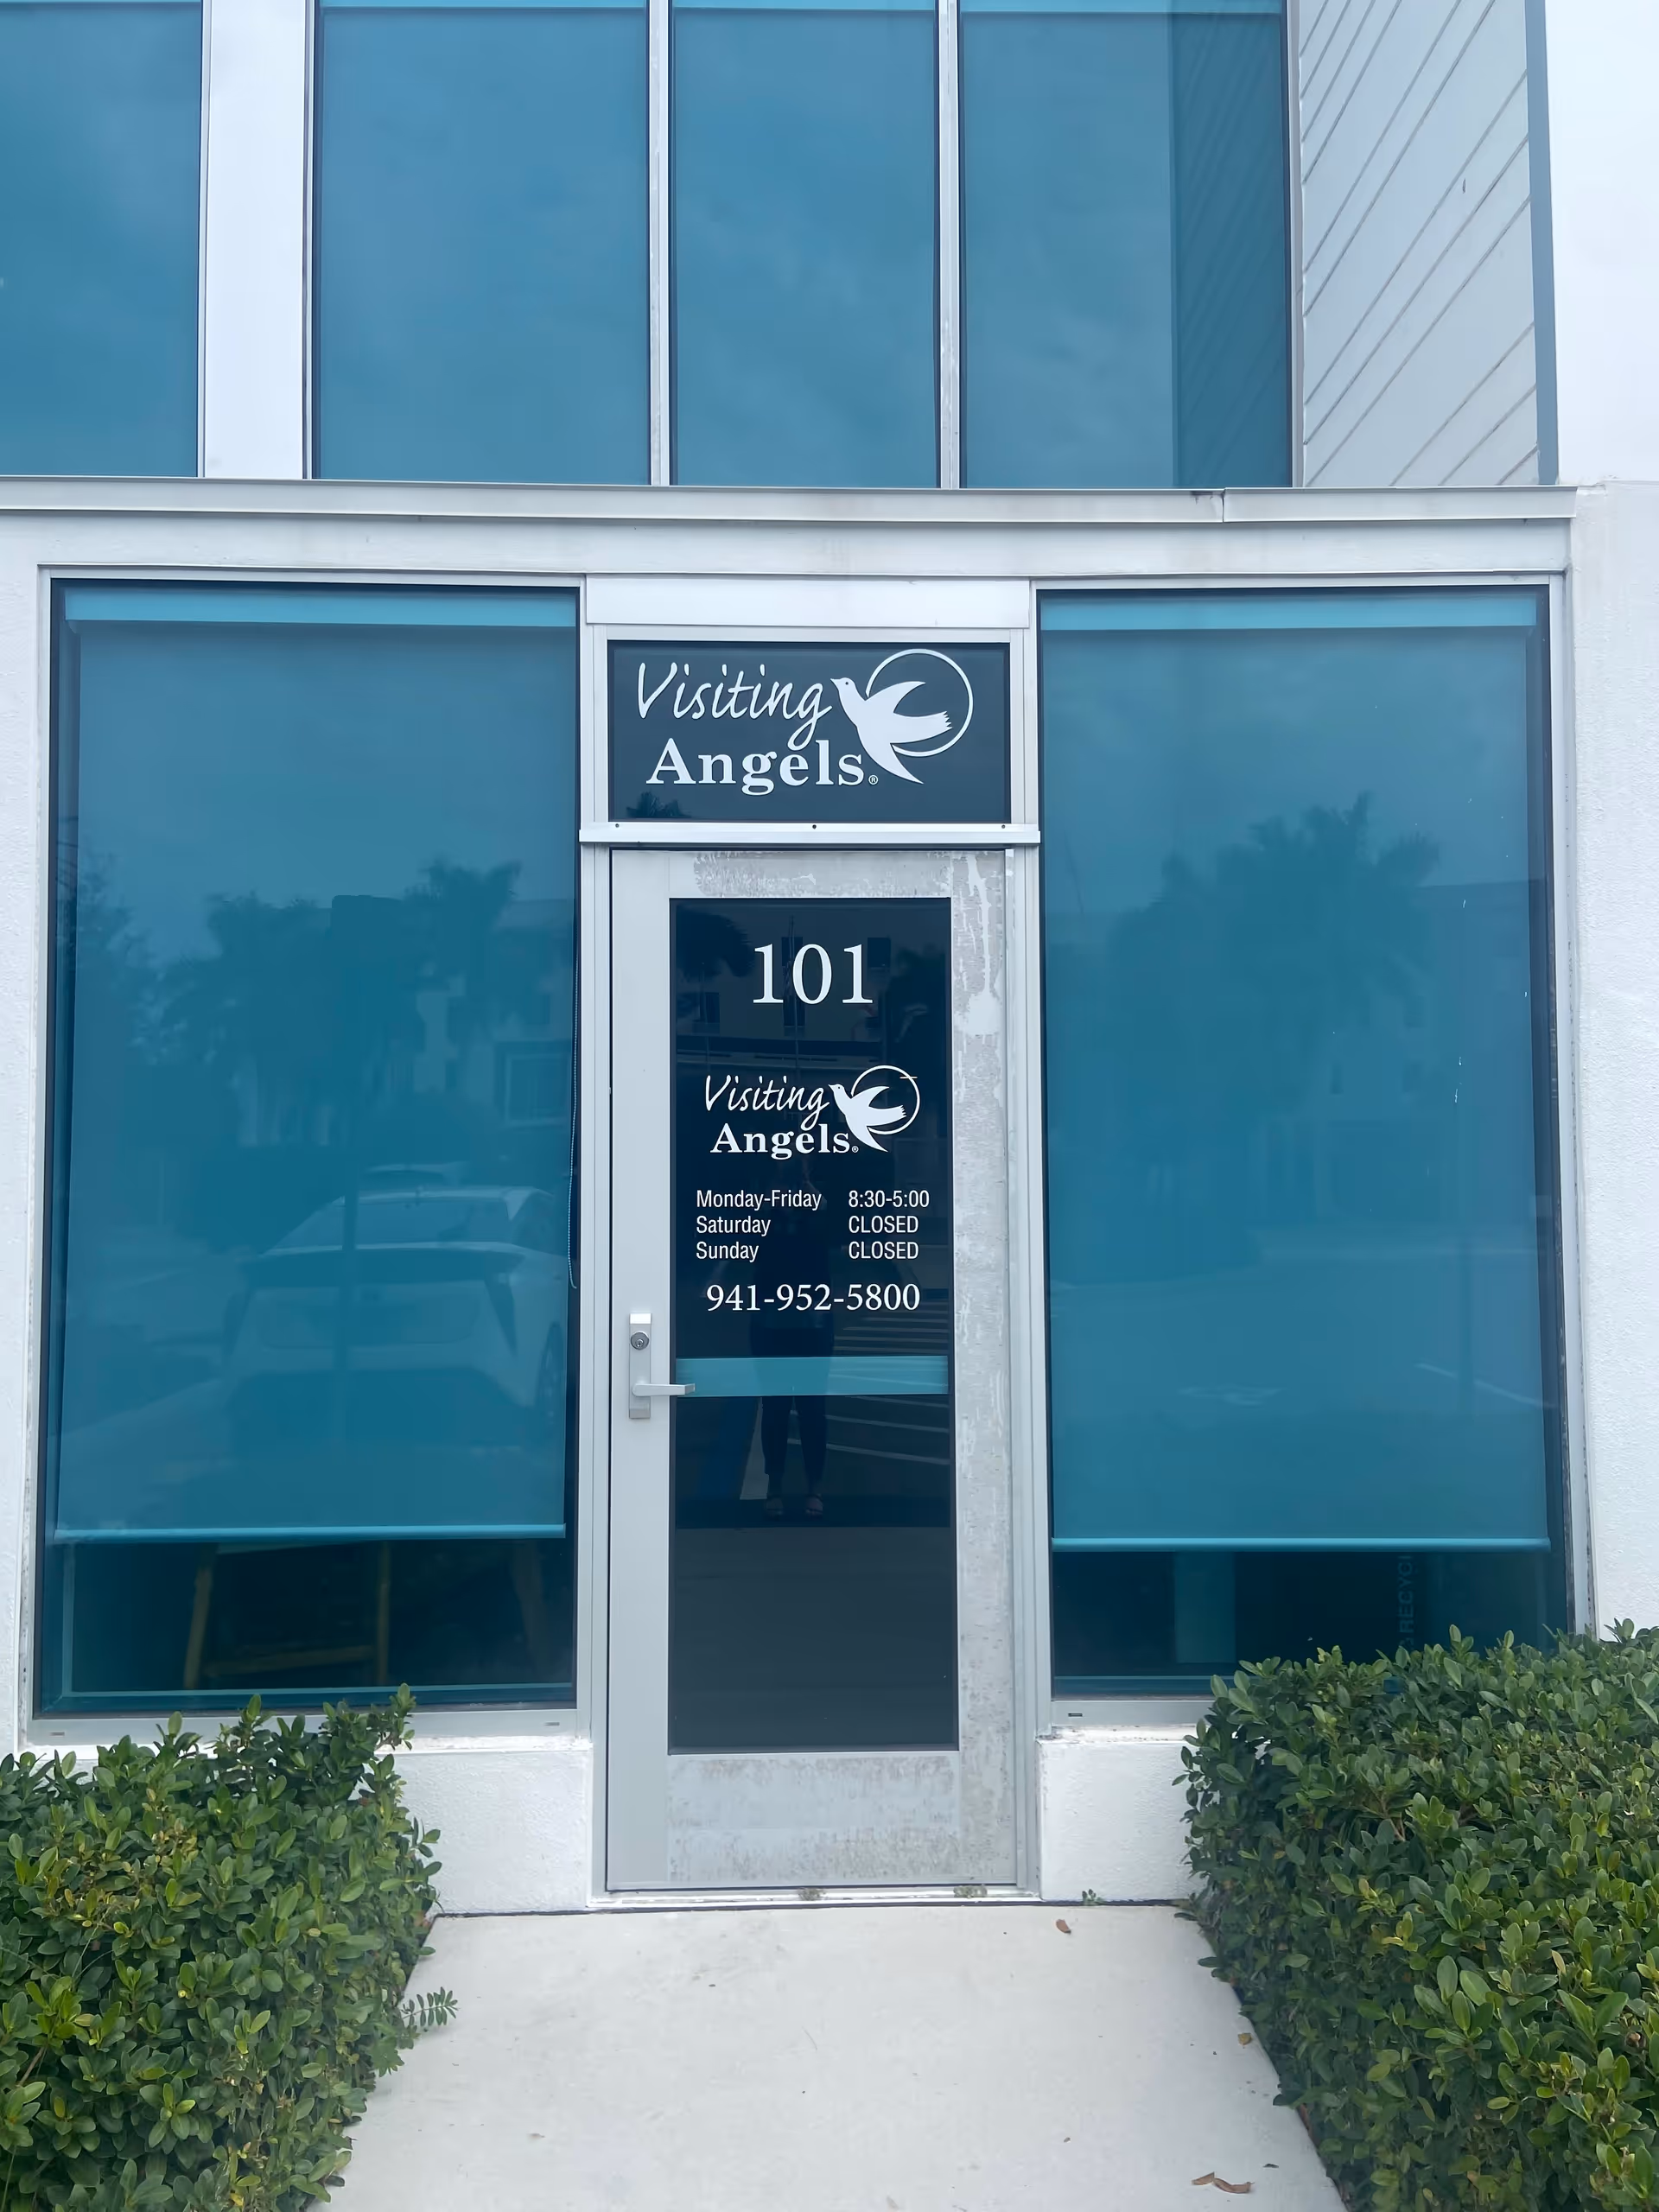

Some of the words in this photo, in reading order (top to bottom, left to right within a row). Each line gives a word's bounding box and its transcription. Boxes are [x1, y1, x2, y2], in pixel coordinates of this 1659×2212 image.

[637, 662, 832, 751] Visiting
[753, 943, 874, 1005] 101
[704, 1074, 830, 1131] Visiting
[696, 1189, 823, 1211] Monday-Friday
[848, 1189, 930, 1208] 8:30-5:00
[696, 1215, 772, 1237] Saturday
[848, 1215, 919, 1234] CLOSED
[696, 1241, 760, 1263] Sunday
[848, 1241, 919, 1260] CLOSED
[706, 1283, 921, 1312] 941-952-5800
